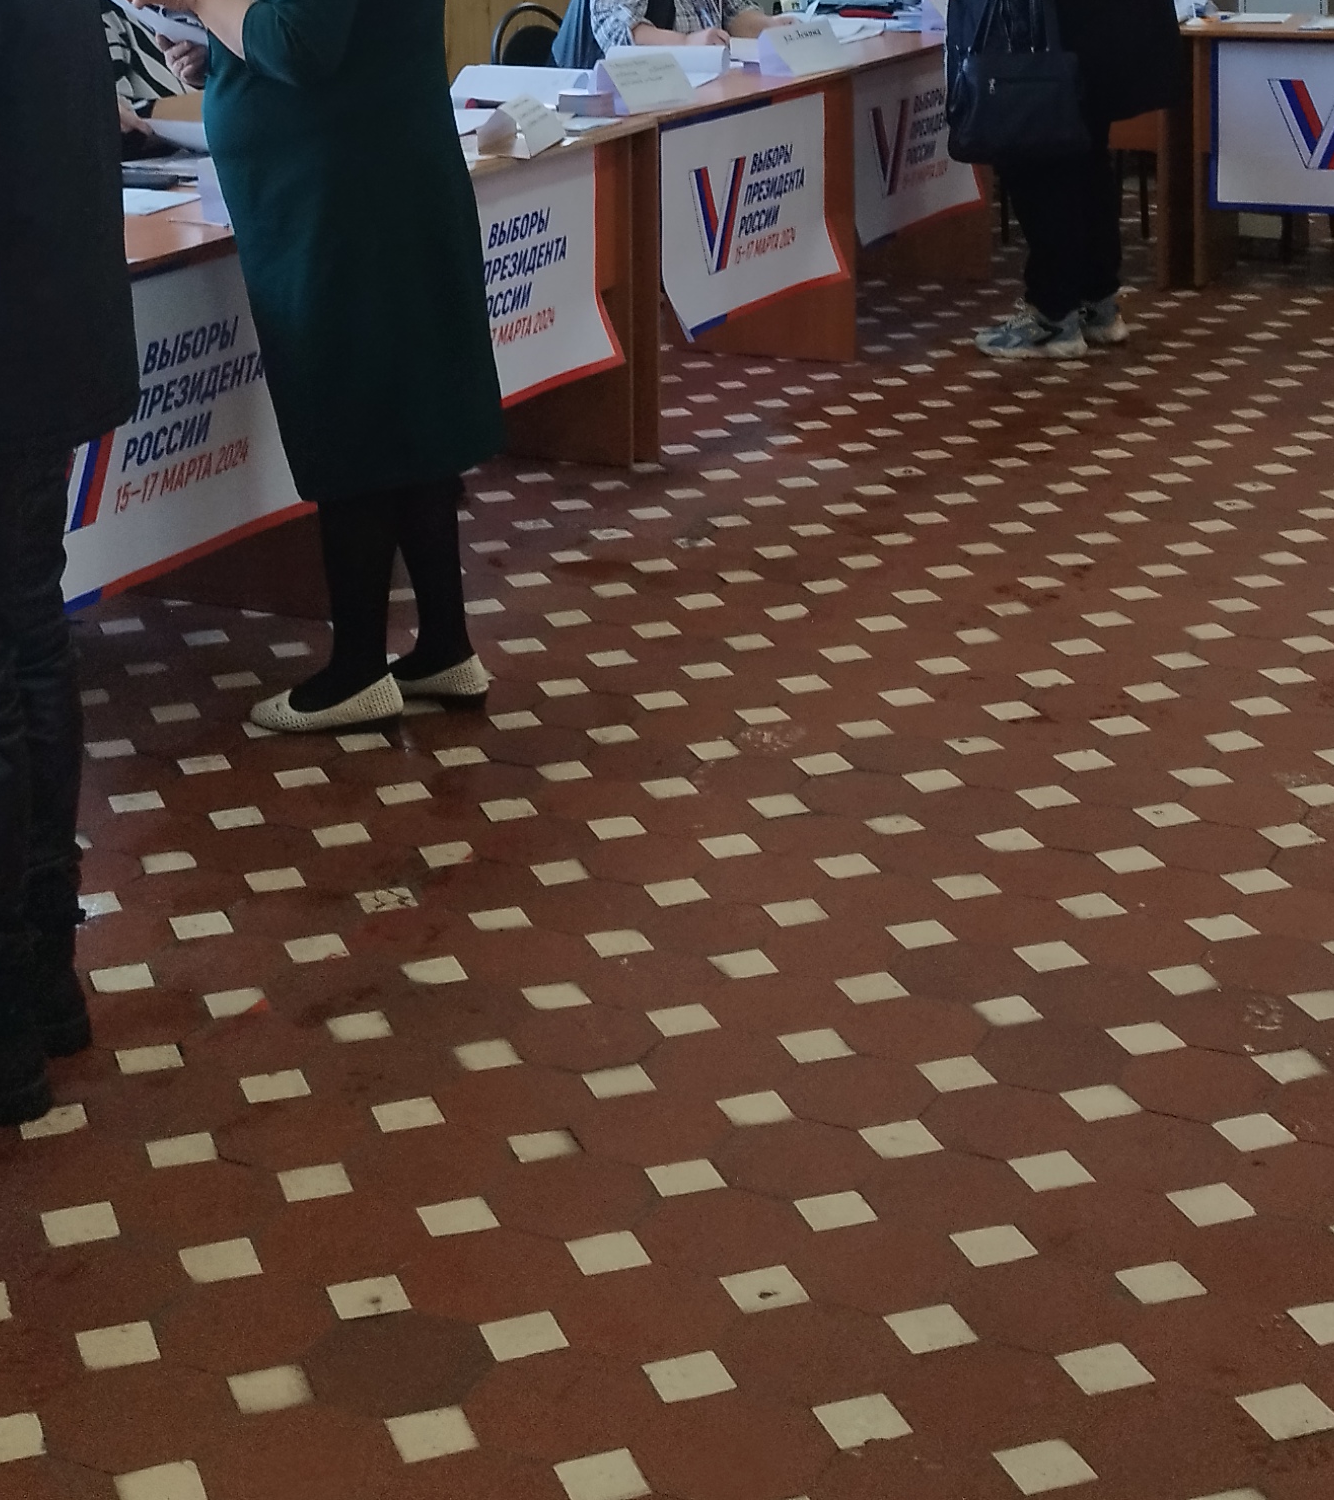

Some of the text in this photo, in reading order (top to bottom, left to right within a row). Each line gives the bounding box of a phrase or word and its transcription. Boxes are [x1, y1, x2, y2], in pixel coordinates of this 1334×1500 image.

[750, 144, 793, 175] ВЫБОРЫ
[743, 166, 805, 207] ПРЕЗИДЕНТА
[488, 206, 551, 250] ВЫБОРЫ
[738, 204, 780, 238] РОССИИ
[755, 232, 779, 260] МАРТА
[487, 282, 532, 319] ОССИИ
[142, 315, 239, 377] ВЫБОРЫ
[496, 315, 532, 348] МАРТА
[533, 306, 555, 335] 2024
[132, 351, 264, 424] ПРЕЗИДЕНТА
[121, 411, 212, 473] РОССИИ
[160, 452, 213, 498] МАРТА
[215, 436, 250, 475] 2024
